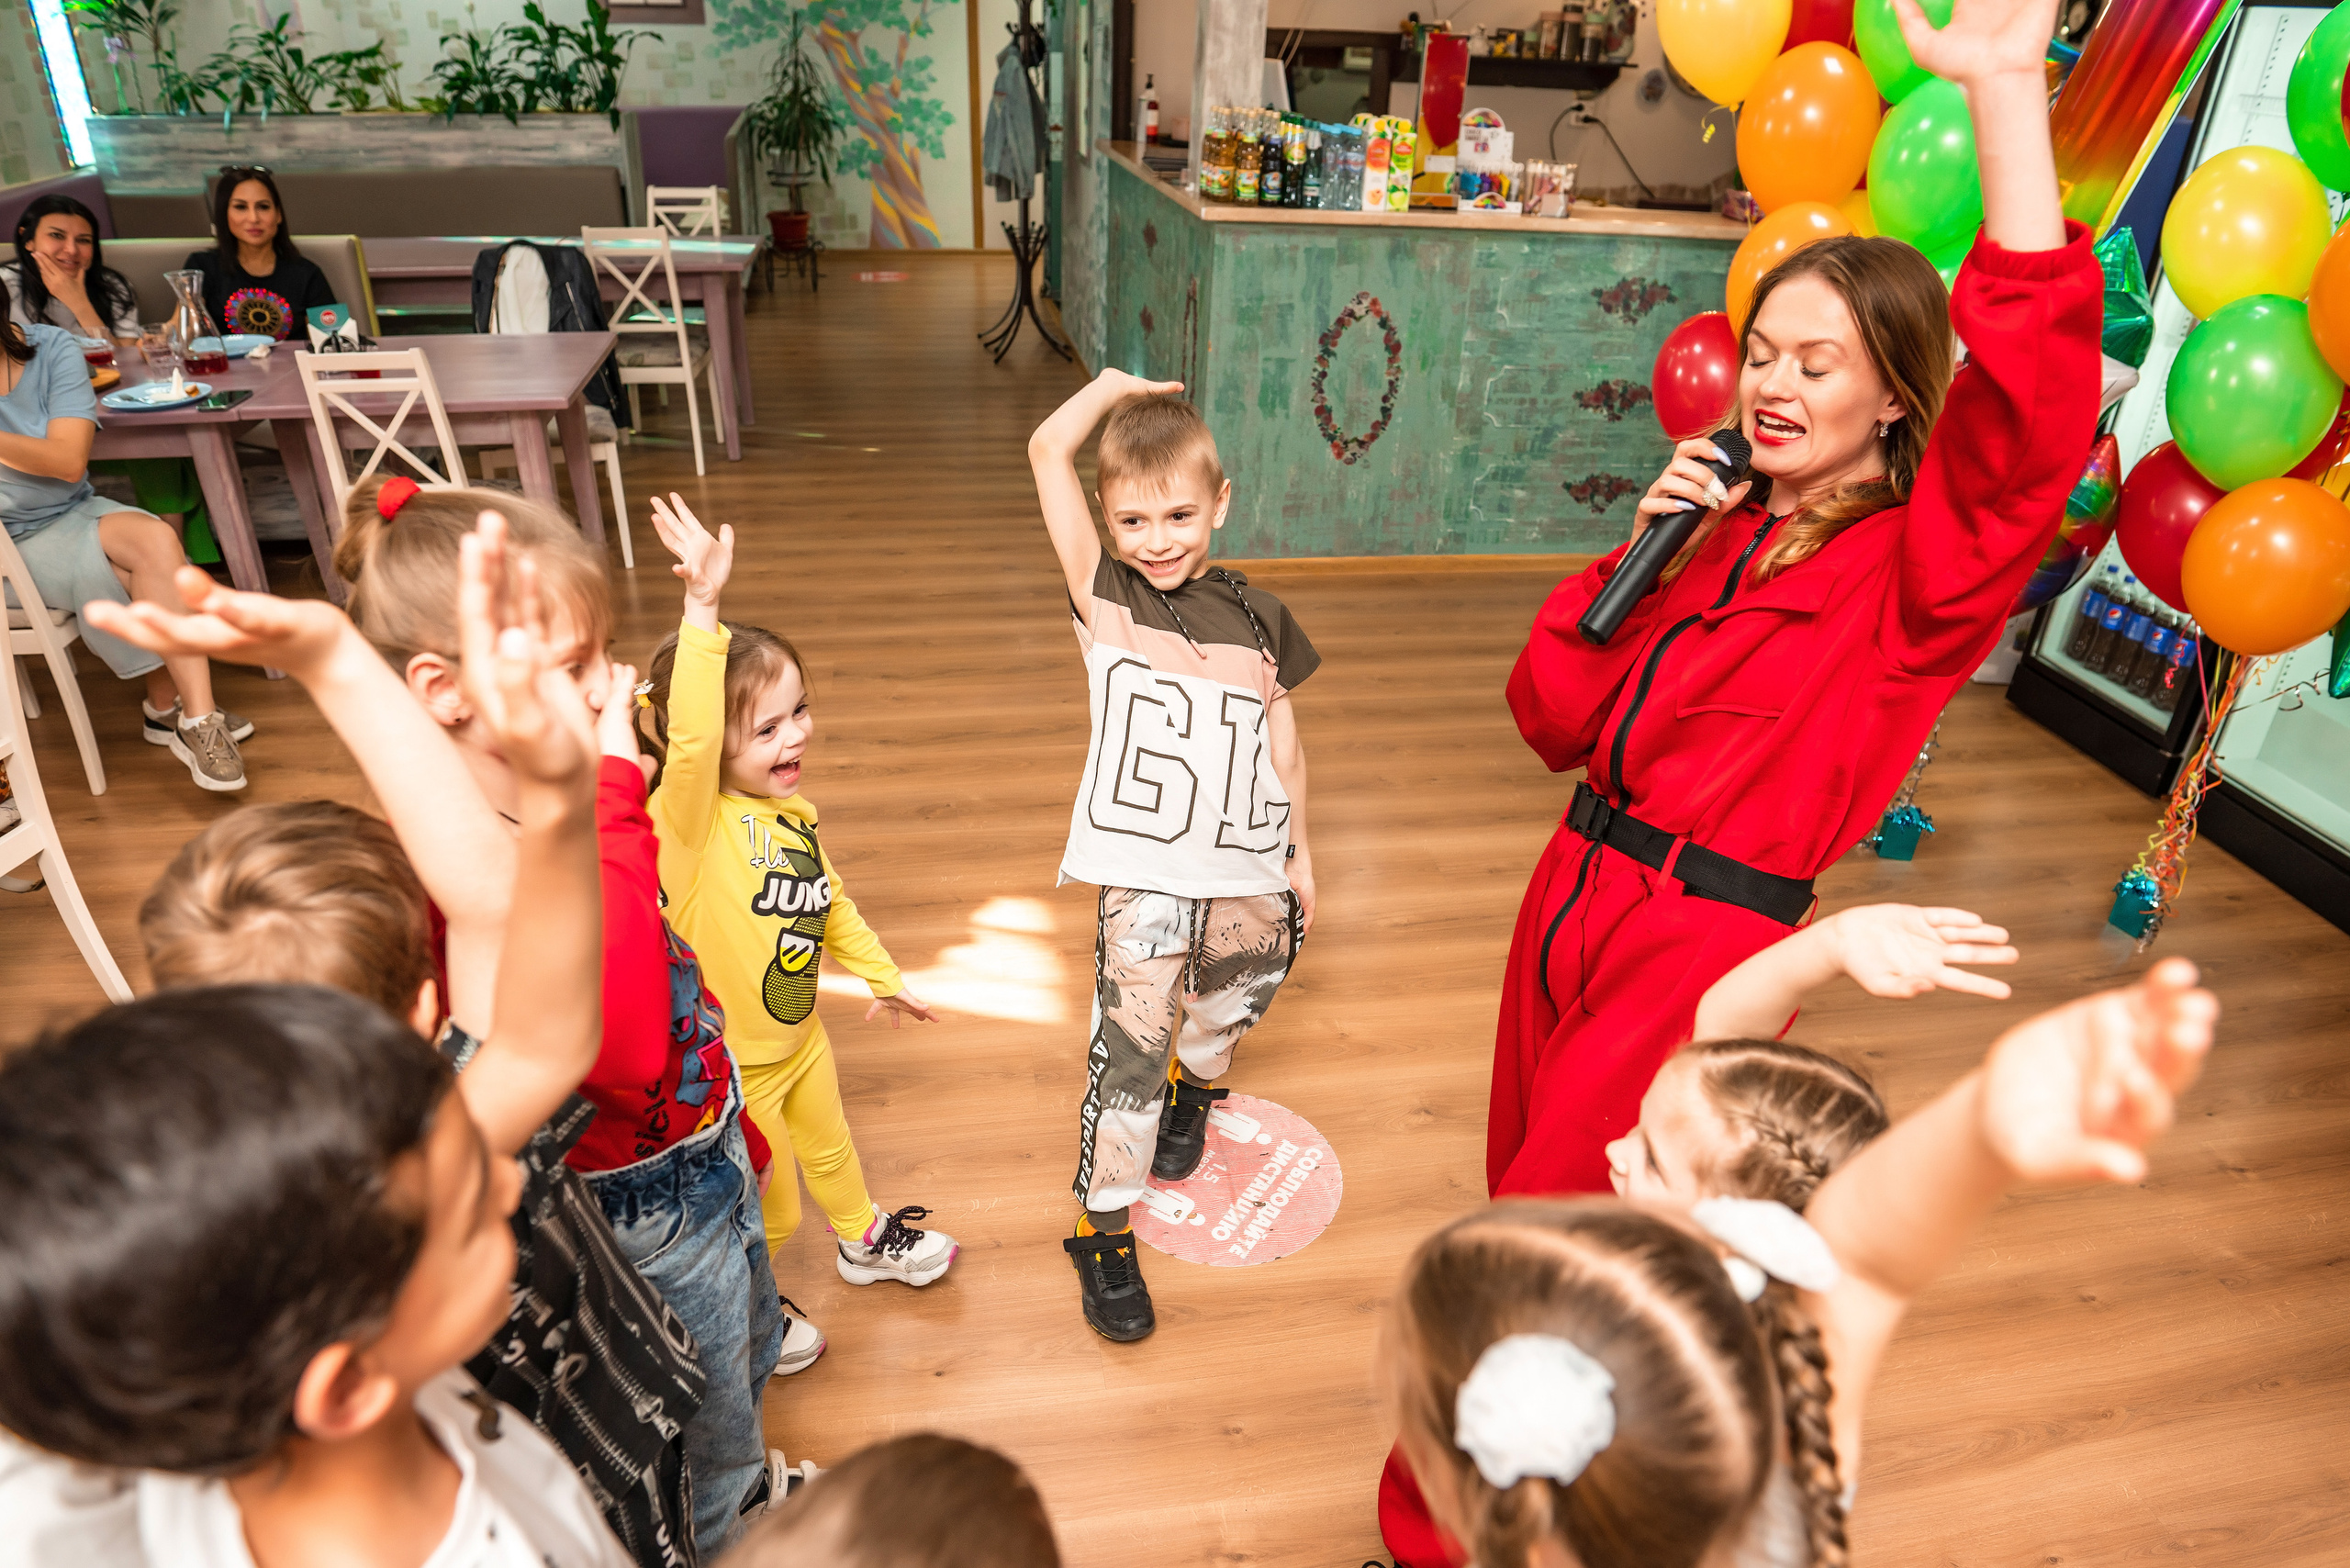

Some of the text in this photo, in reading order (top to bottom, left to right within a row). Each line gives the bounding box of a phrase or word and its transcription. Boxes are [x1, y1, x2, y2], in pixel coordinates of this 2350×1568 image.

[1203, 1162, 1228, 1184] 1,5
[1211, 1138, 1300, 1241] ДИСТАНЦИЮ
[1227, 1148, 1324, 1260] СОБЛЮДАЙТЕ
